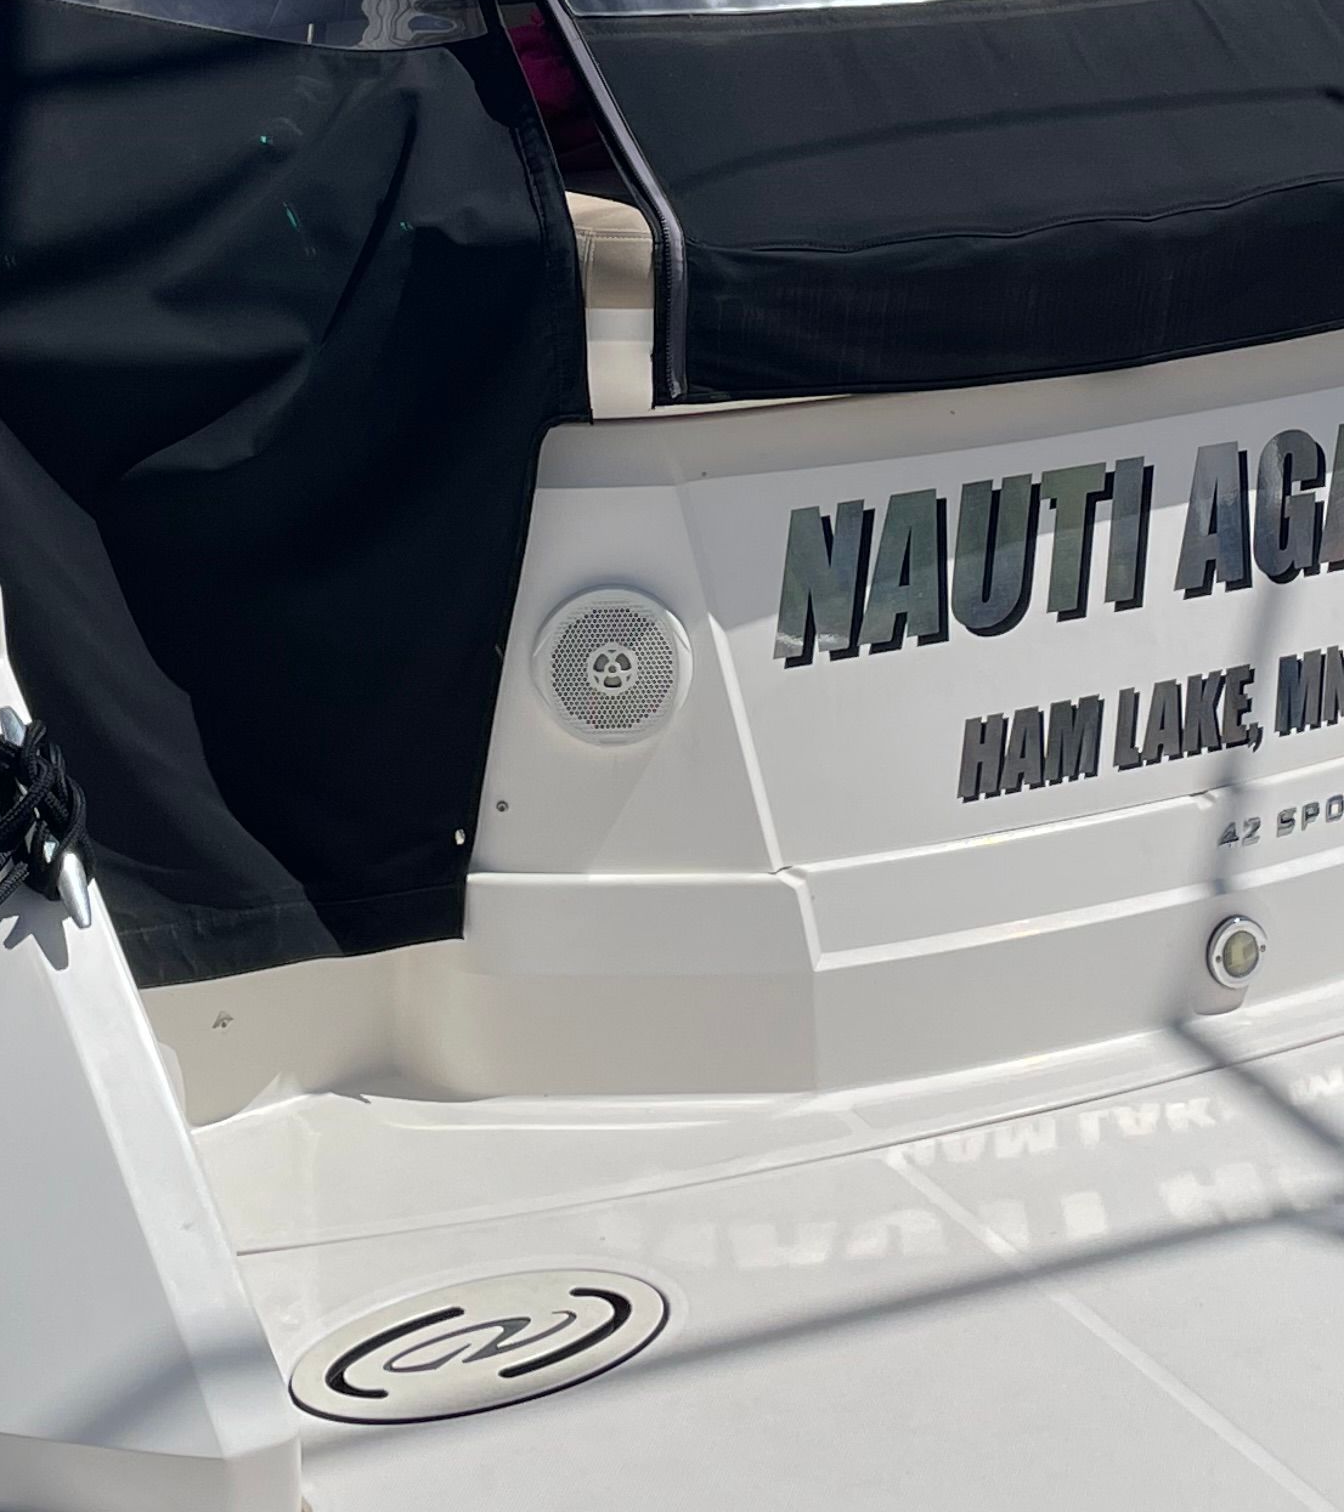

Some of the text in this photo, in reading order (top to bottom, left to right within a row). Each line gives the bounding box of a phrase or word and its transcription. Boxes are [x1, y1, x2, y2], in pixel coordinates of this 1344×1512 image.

[773, 455, 1155, 669] NAUTI
[956, 693, 1105, 803] HAM
[1113, 663, 1263, 773] LAKE,
[1217, 816, 1262, 848] 42
